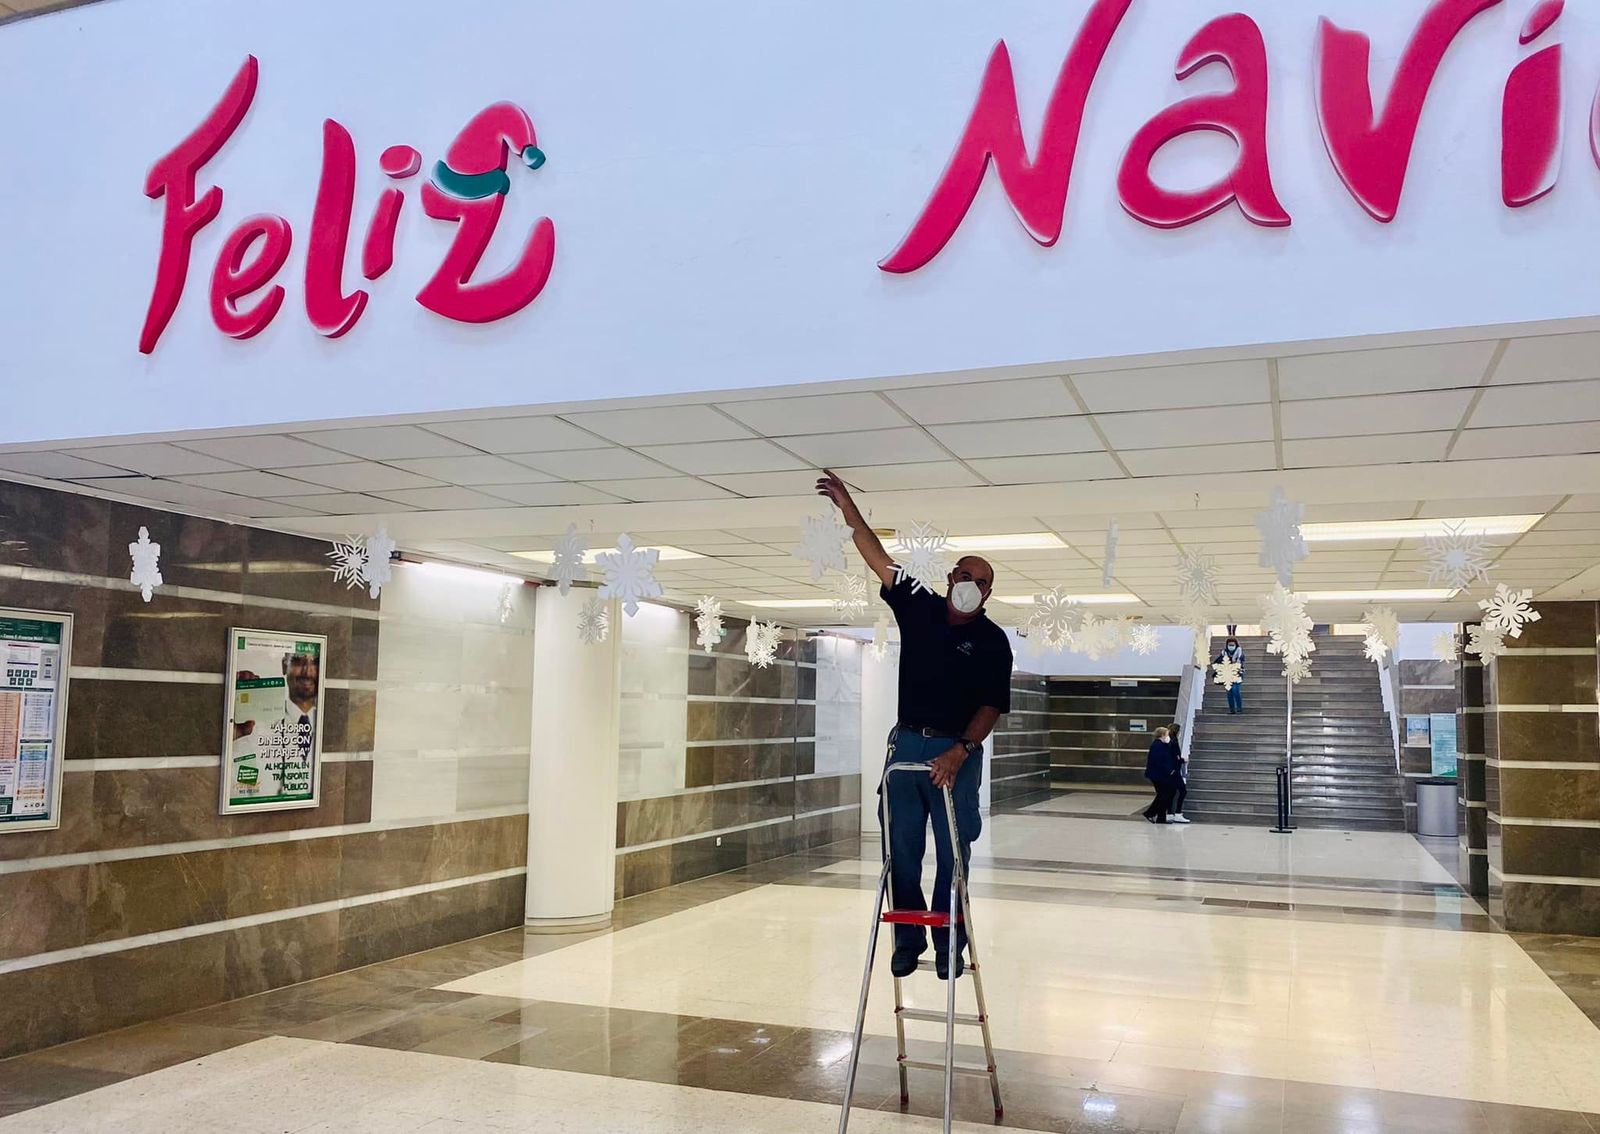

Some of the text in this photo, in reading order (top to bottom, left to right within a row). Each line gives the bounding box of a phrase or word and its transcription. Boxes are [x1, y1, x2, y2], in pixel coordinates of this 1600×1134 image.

[138, 0, 1600, 355] Feliz Navi
[257, 735, 311, 746] DINERO CON
[260, 748, 271, 759] MI
[264, 761, 310, 771] AL HOSPITAL EN
[272, 771, 310, 781] TRANSPORTE
